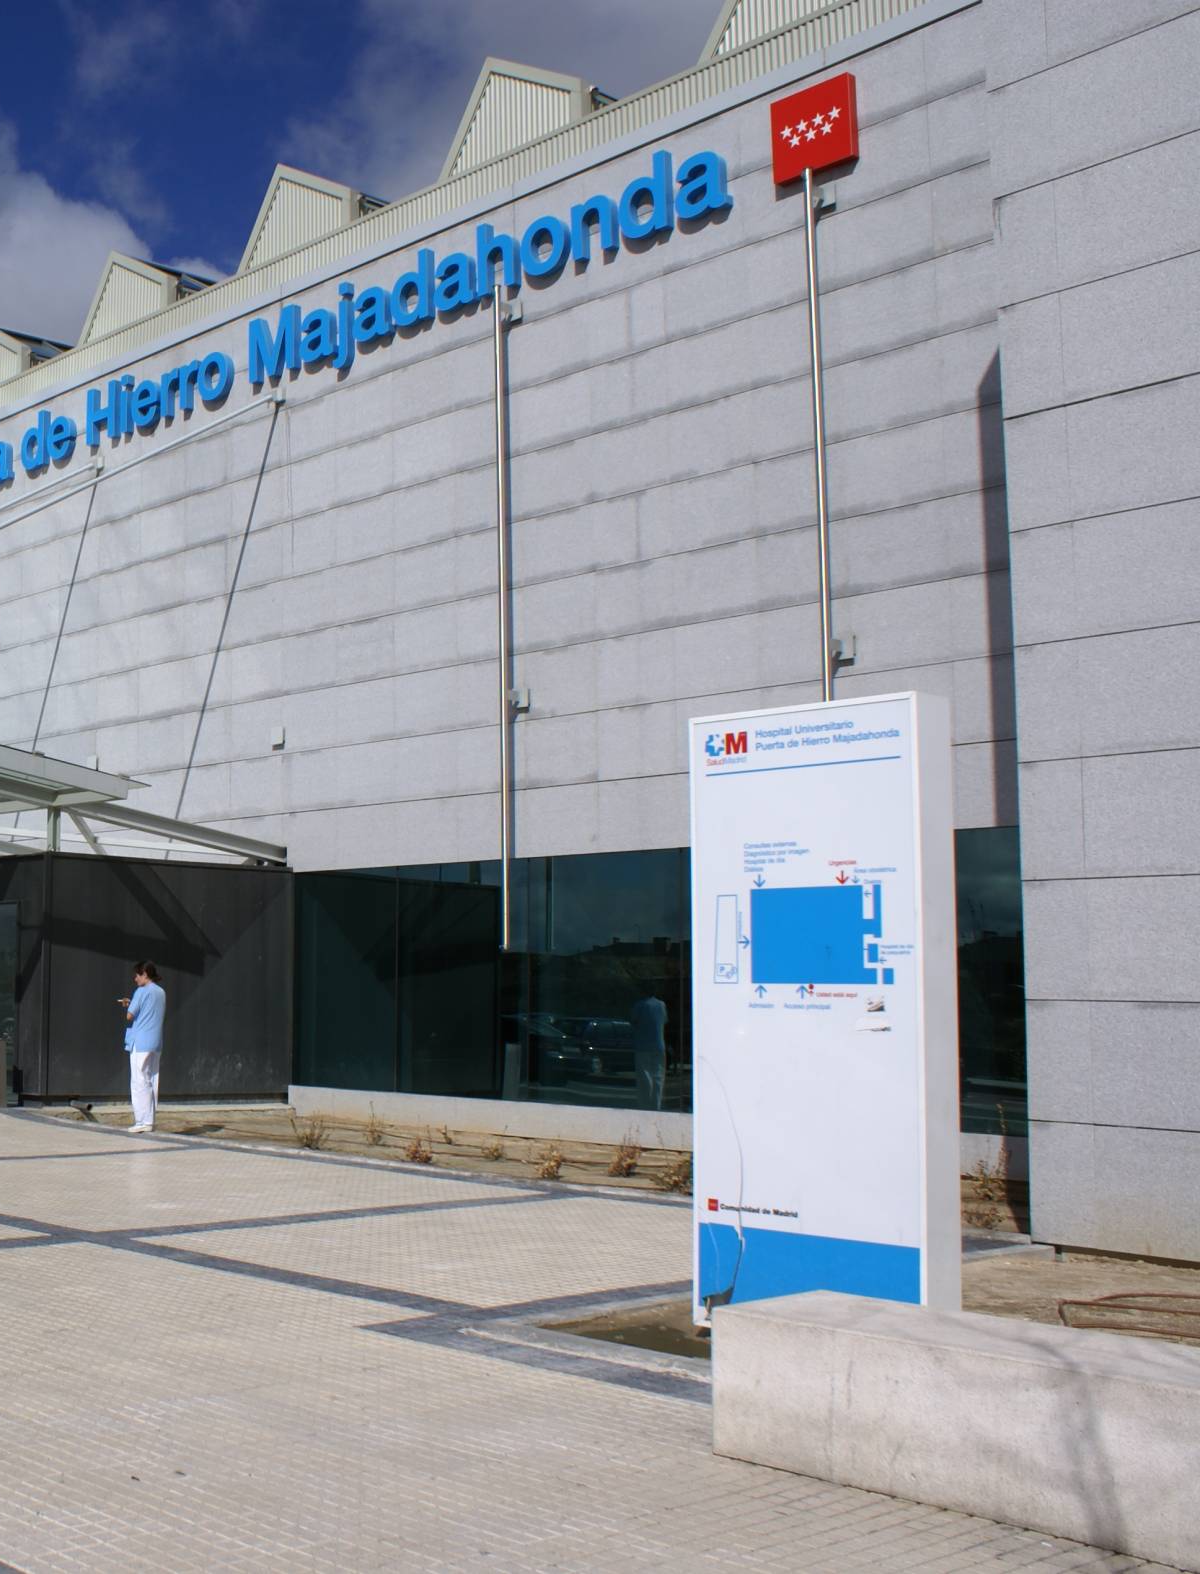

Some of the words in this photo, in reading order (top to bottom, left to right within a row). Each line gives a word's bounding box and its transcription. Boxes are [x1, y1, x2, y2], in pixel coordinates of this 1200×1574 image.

[21, 410, 77, 472] de
[86, 351, 235, 447] Hierro
[248, 149, 734, 385] Majadahonda
[755, 725, 793, 740] Hospital
[794, 719, 854, 735] Universitario
[755, 740, 786, 752] Puerta
[787, 737, 799, 749] de
[801, 735, 831, 747] Hierro
[832, 728, 901, 746] Majadahonda
[720, 1203, 761, 1214] Comunidad
[773, 1208, 798, 1218] Madrid
